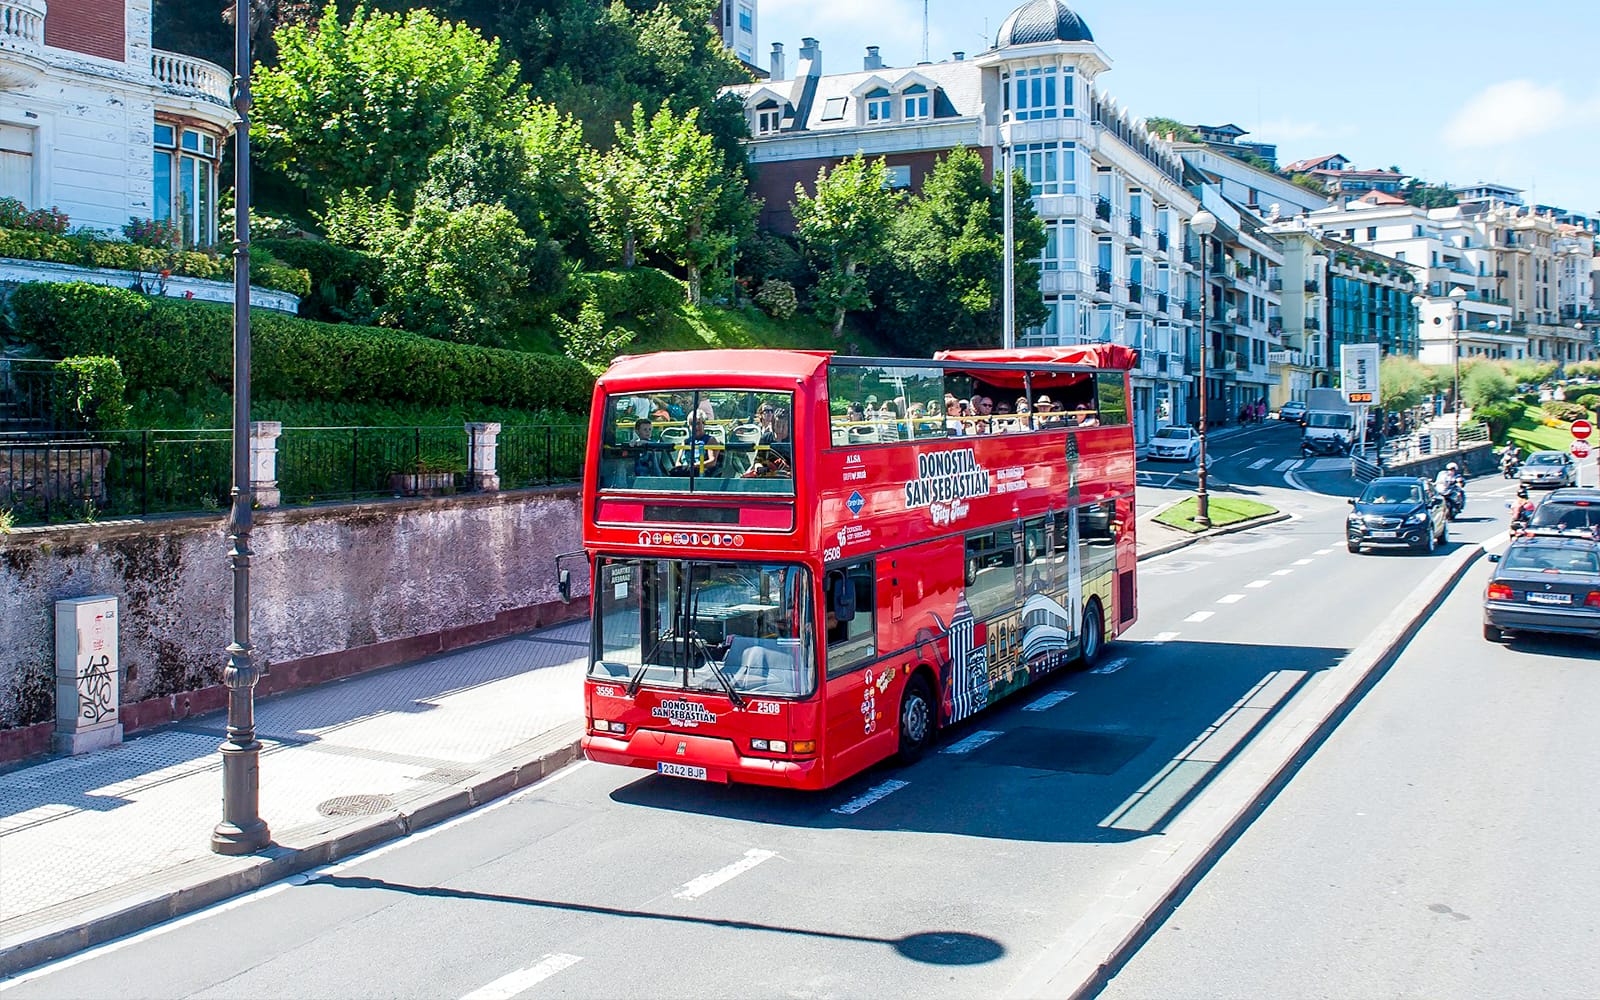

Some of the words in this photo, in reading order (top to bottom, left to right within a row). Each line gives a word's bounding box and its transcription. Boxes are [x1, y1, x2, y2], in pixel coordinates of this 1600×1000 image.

[846, 454, 861, 464] ALSA
[918, 449, 975, 479] DONOSTIA
[905, 480, 930, 508] SAN
[932, 465, 989, 500] SEBASTIÁN
[931, 502, 950, 524] City
[951, 500, 969, 521] Tour
[824, 546, 841, 562] 2508
[595, 686, 615, 697] 3556
[661, 699, 705, 713] DONOSTIA
[757, 702, 781, 714] 2508
[652, 707, 669, 718] SAN
[670, 709, 716, 723] SEBASTIÁN
[663, 764, 686, 777] 2342
[688, 767, 705, 779] BJP
